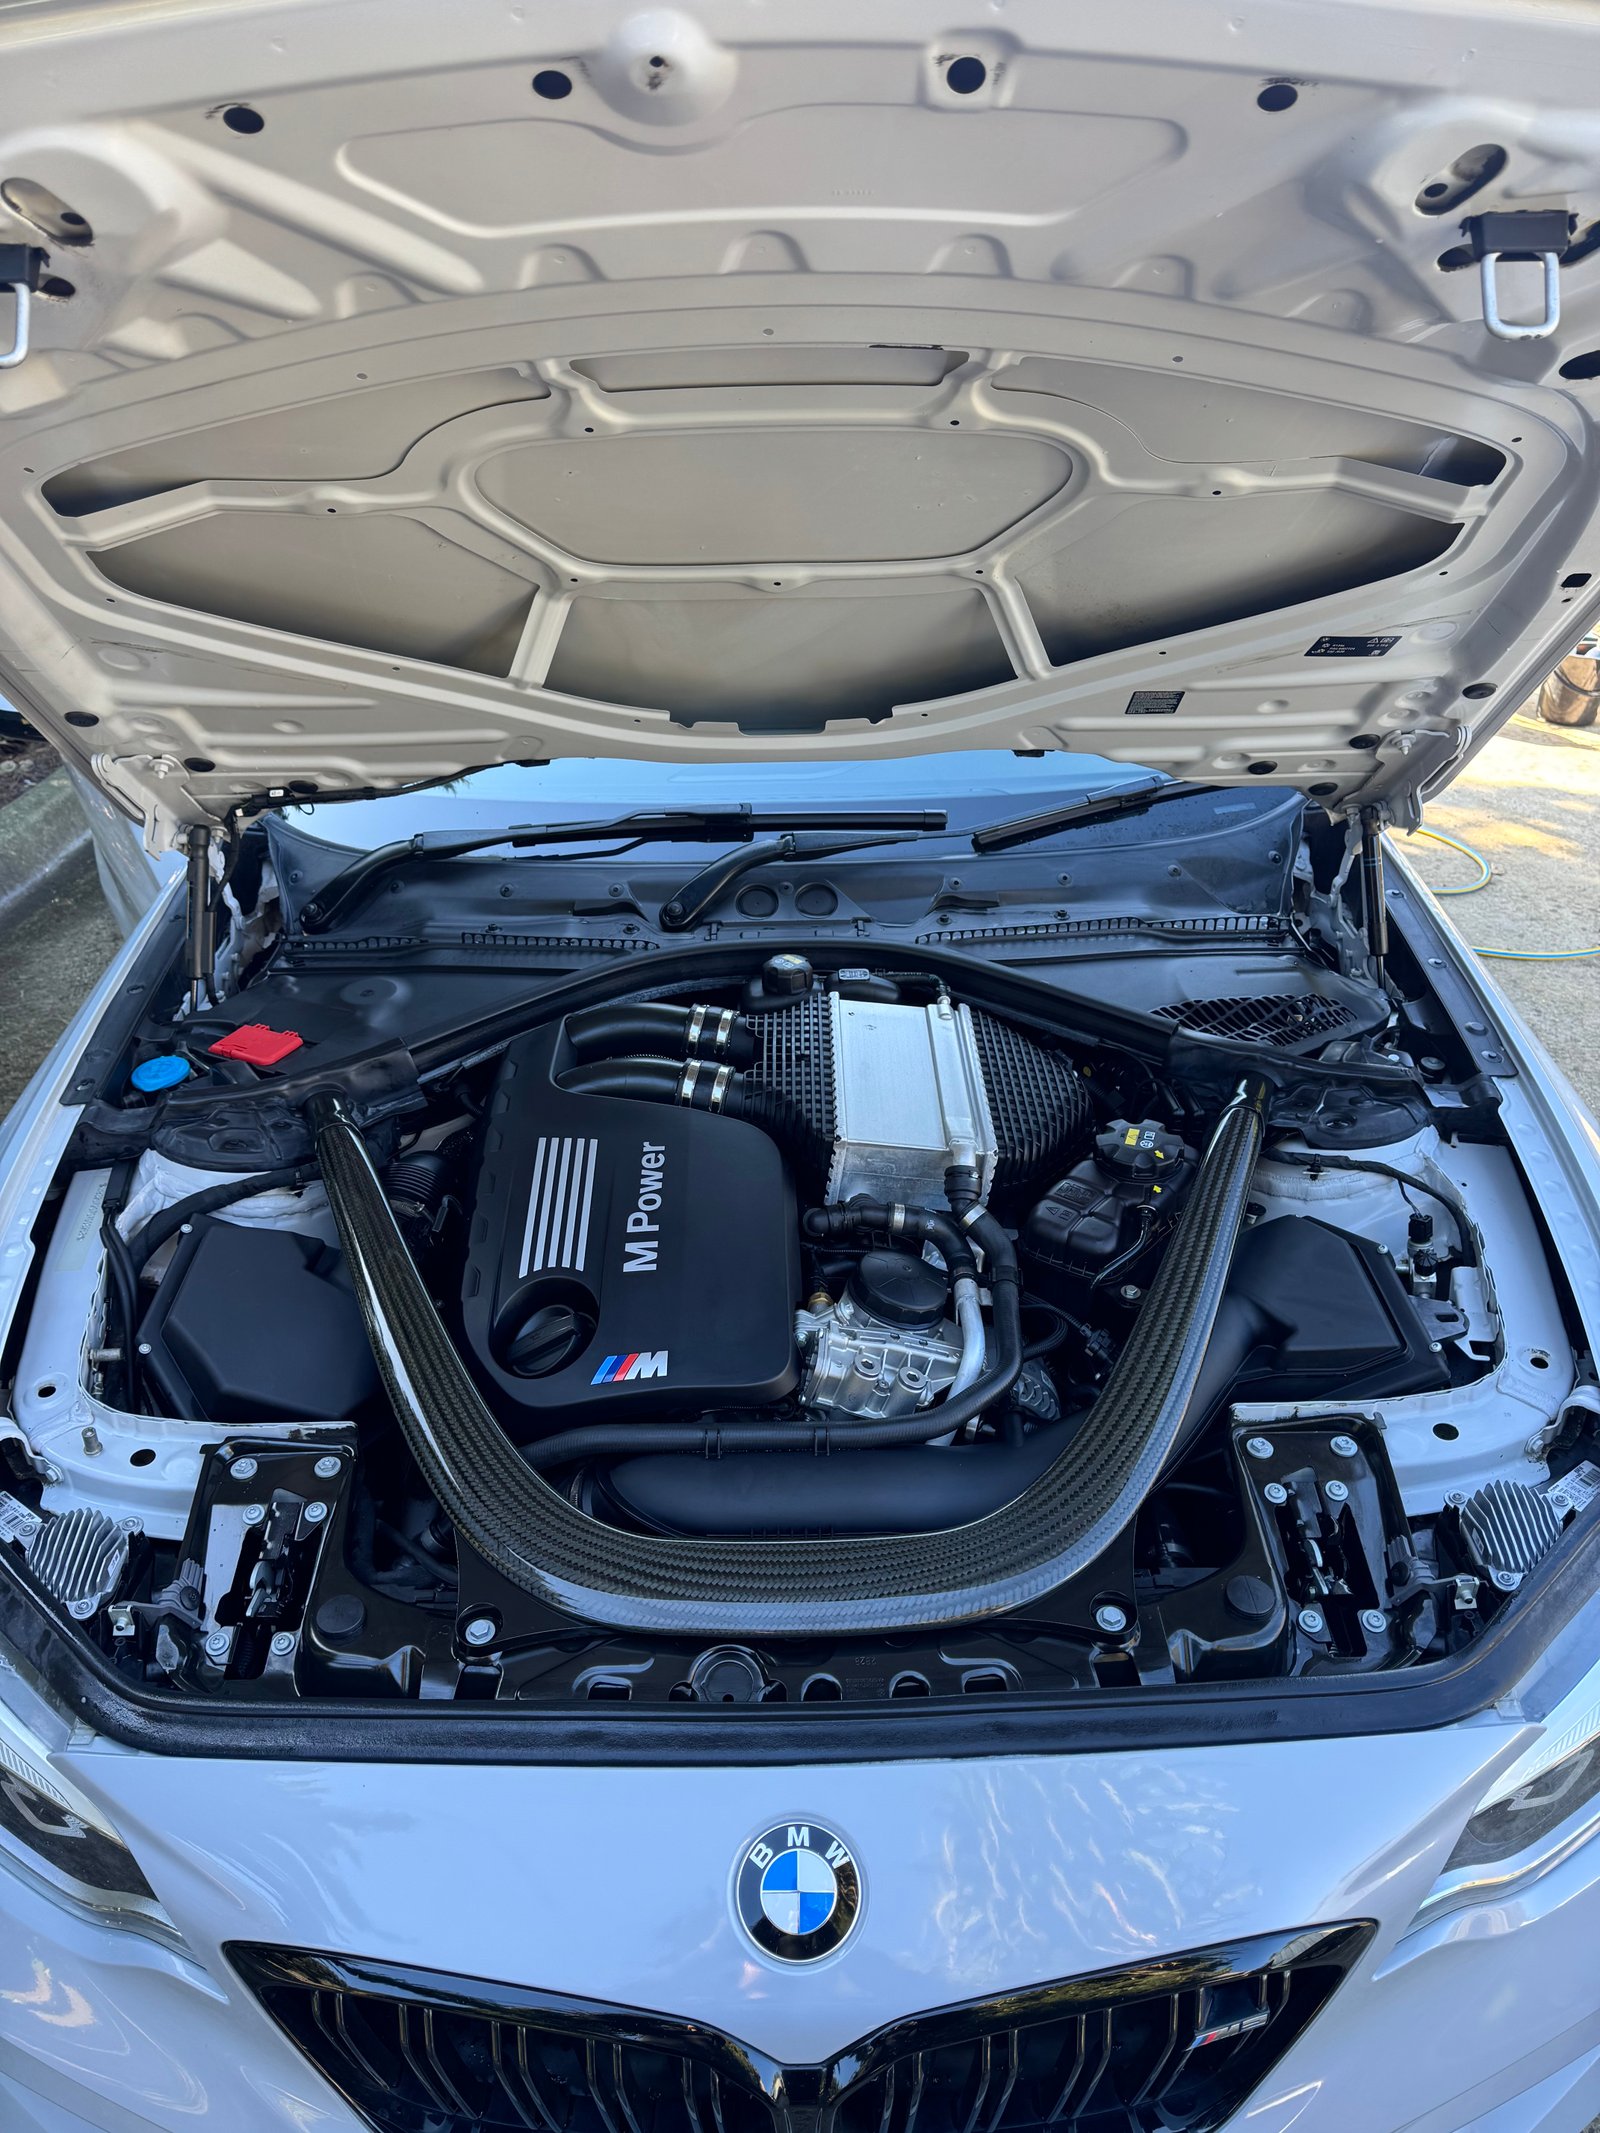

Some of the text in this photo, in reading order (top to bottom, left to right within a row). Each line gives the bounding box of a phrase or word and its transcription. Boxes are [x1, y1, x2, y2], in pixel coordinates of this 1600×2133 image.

[622, 1141, 666, 1273] M Power
[622, 1350, 669, 1381] M
[749, 1826, 850, 1869] BMW
